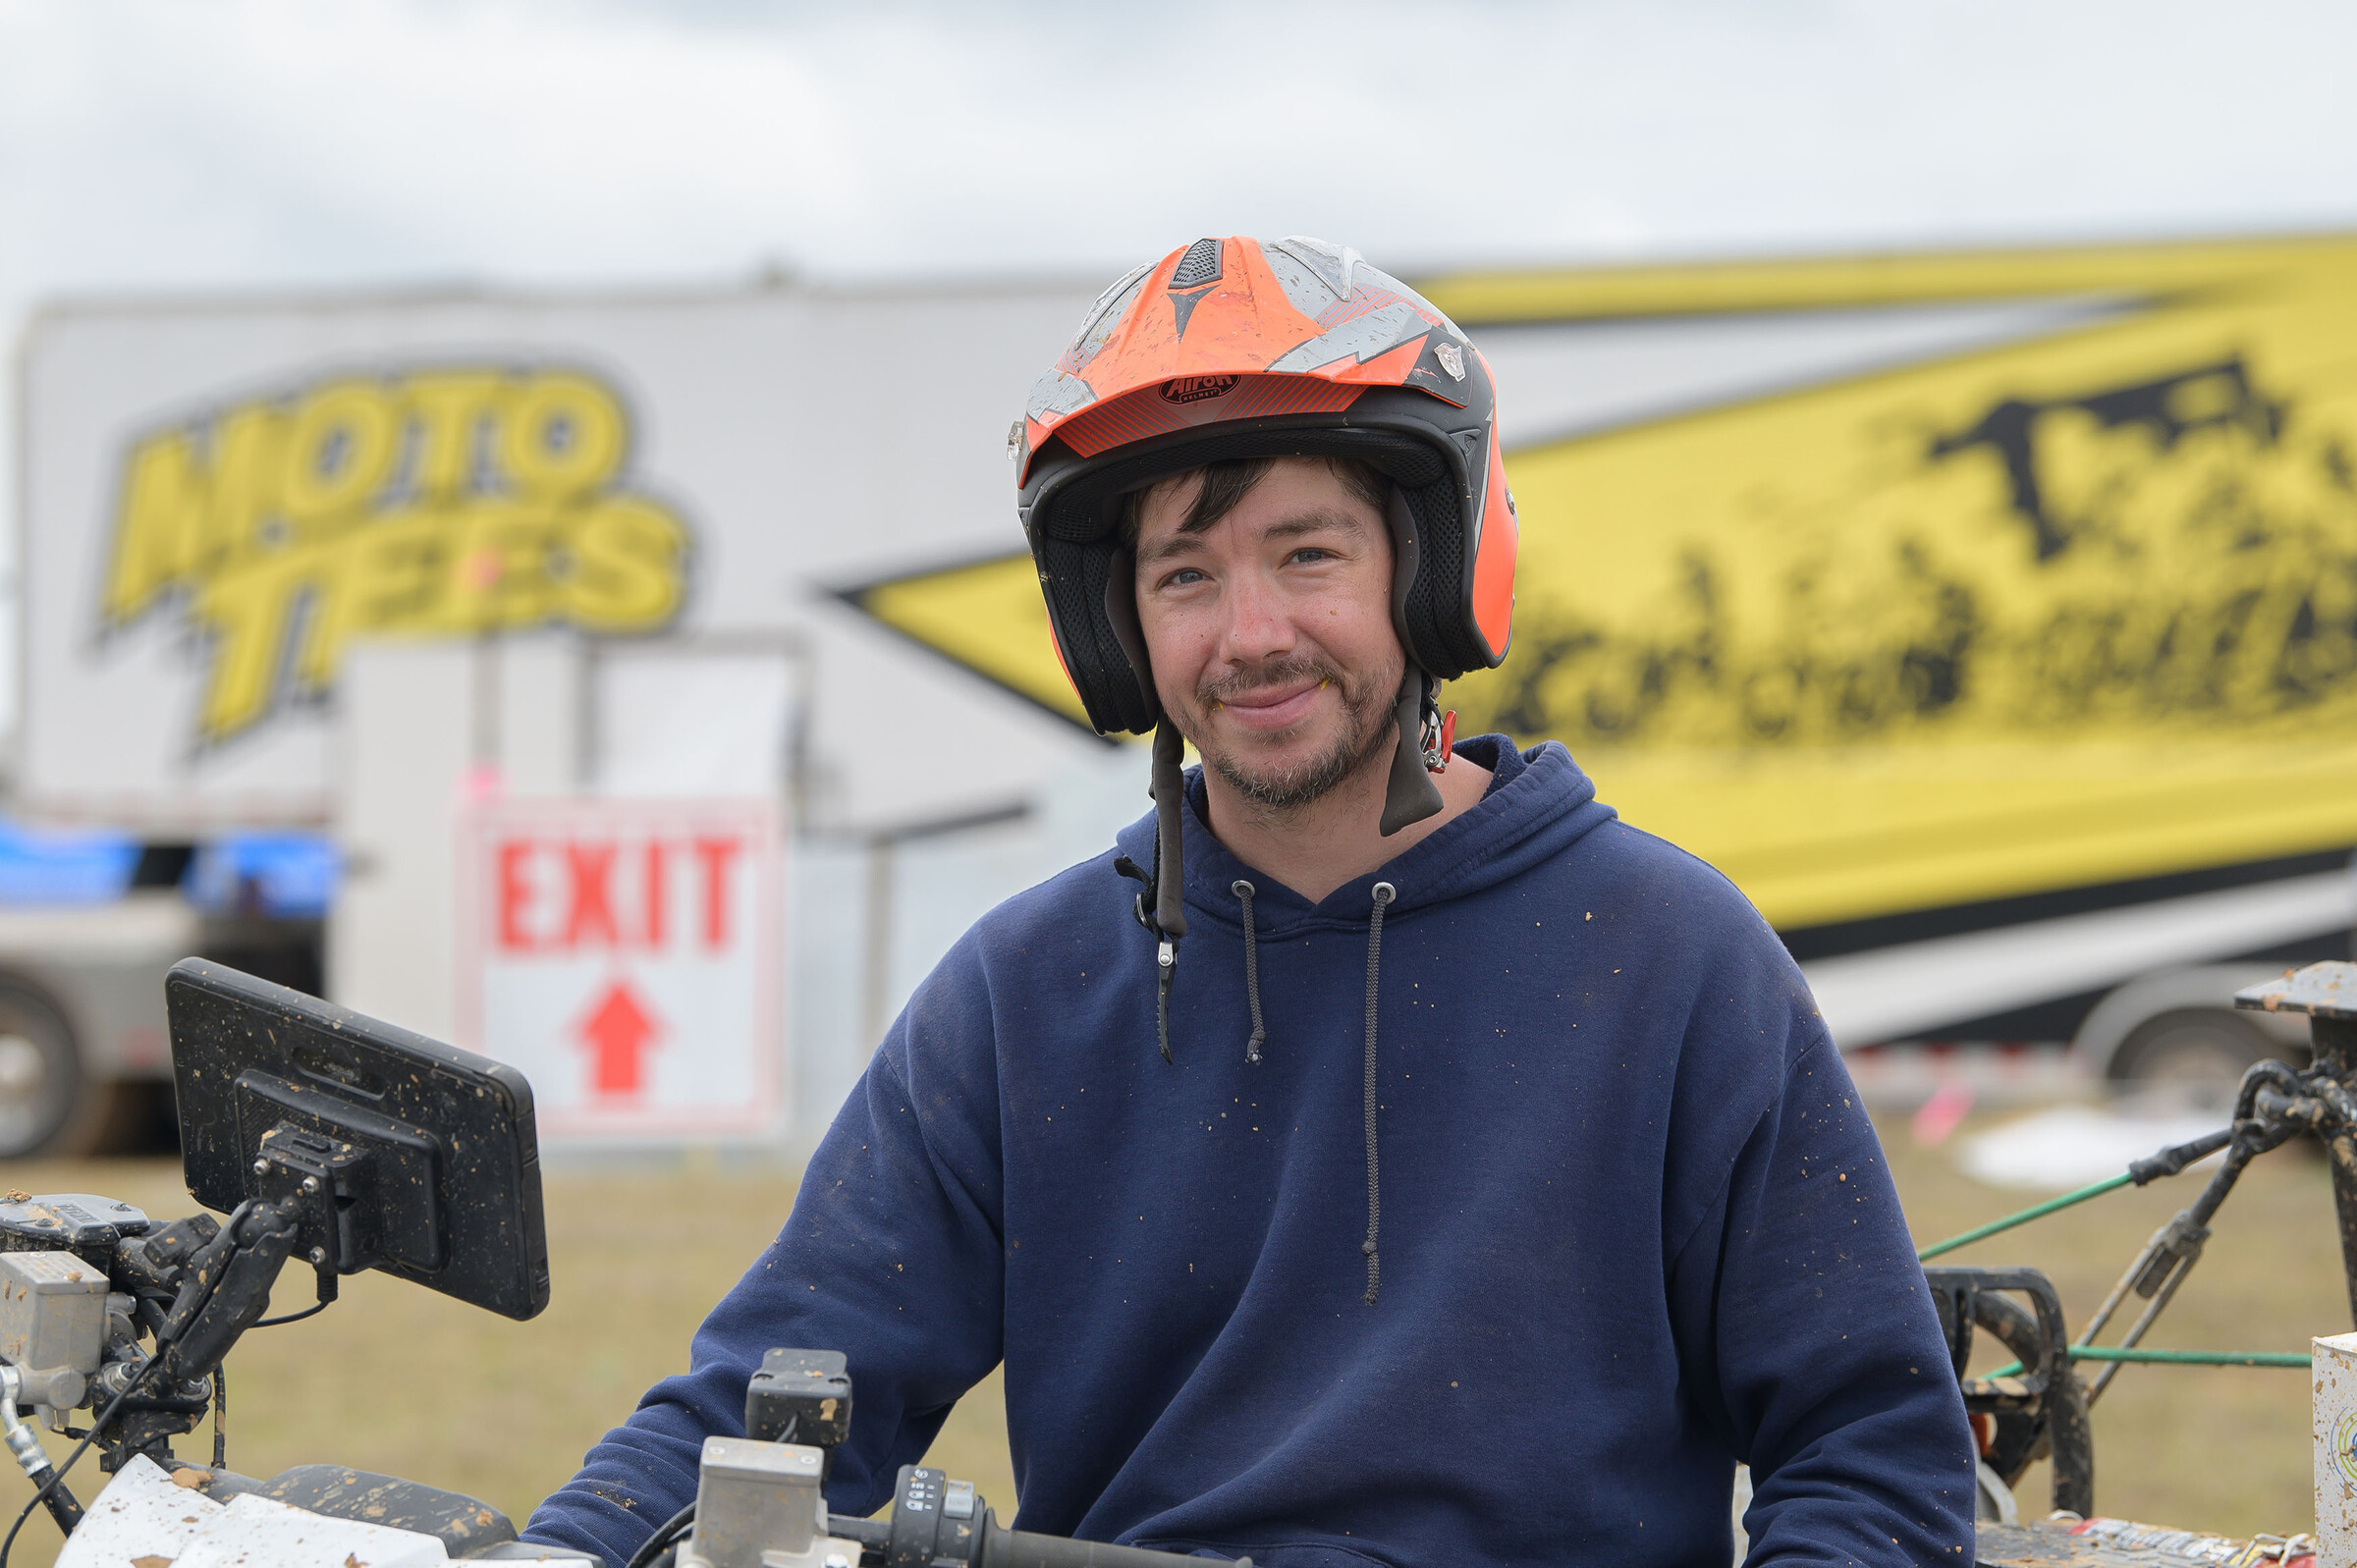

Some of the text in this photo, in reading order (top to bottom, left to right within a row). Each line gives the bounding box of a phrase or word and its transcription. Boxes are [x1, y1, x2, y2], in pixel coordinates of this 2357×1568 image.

[104, 369, 629, 628] MOTO
[192, 497, 687, 746] TEES
[495, 835, 742, 952] EXIT
